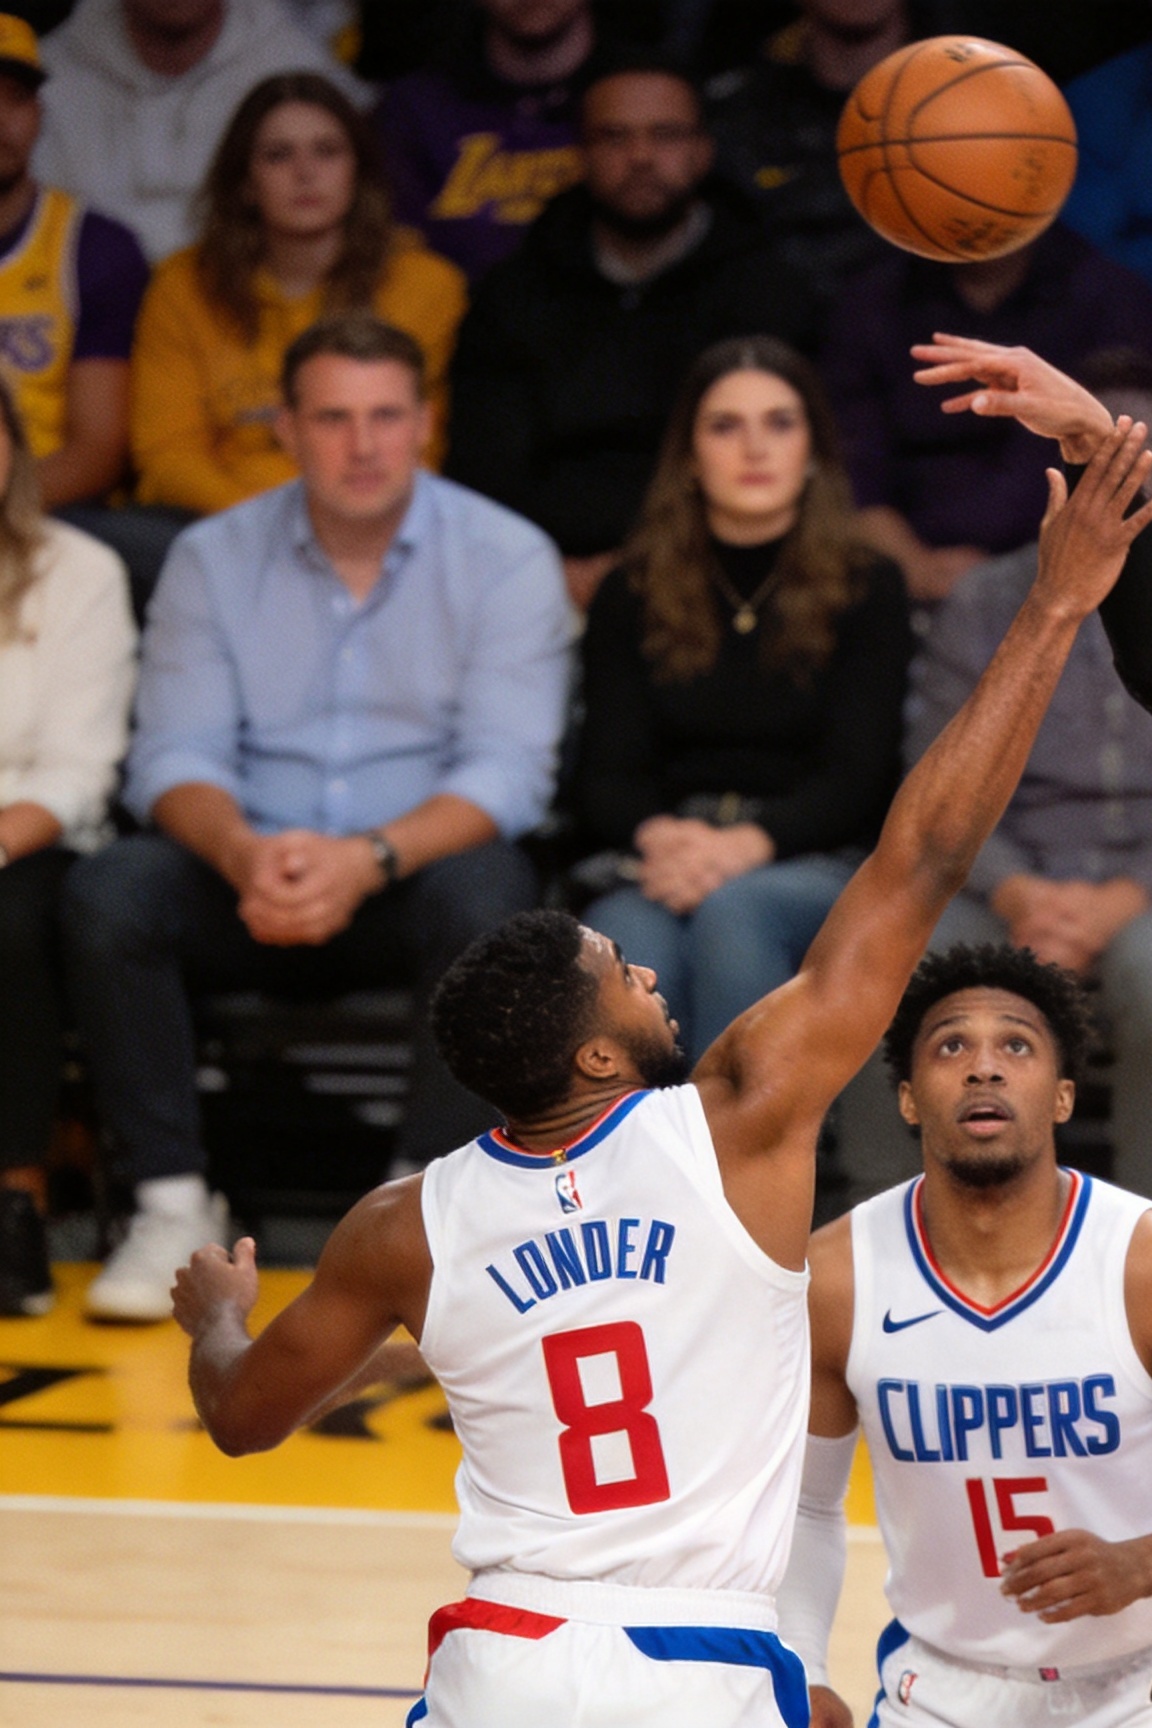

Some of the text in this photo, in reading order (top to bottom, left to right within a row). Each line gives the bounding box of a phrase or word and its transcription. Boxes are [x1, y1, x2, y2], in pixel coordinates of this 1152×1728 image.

[485, 1218, 675, 1314] LONDER
[541, 1321, 671, 1515] 8
[877, 1374, 1121, 1462] CLIPPERS
